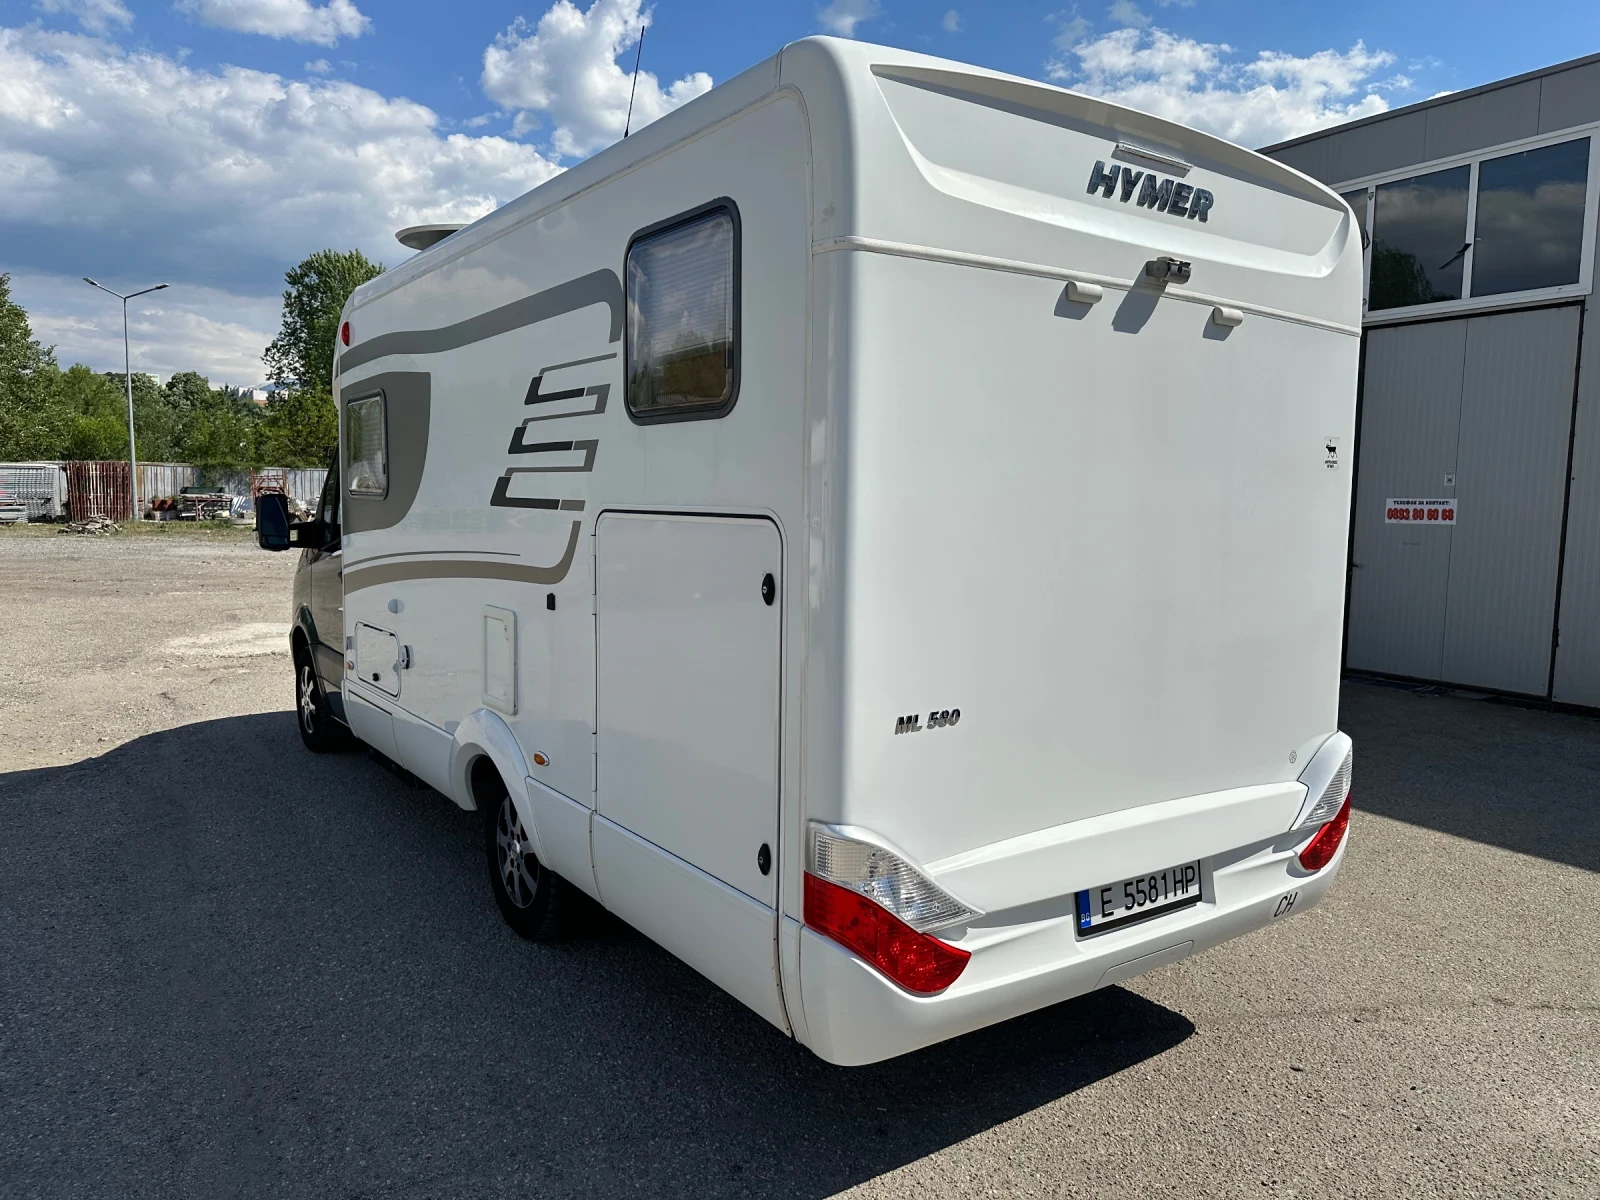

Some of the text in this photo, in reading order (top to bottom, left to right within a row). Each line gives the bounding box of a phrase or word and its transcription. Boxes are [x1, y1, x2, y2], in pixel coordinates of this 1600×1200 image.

[1086, 160, 1214, 223] HYMER
[894, 708, 961, 735] ML 580
[1100, 865, 1196, 918] E 5581 HP
[1273, 891, 1299, 918] CH
[1080, 912, 1090, 923] BG
